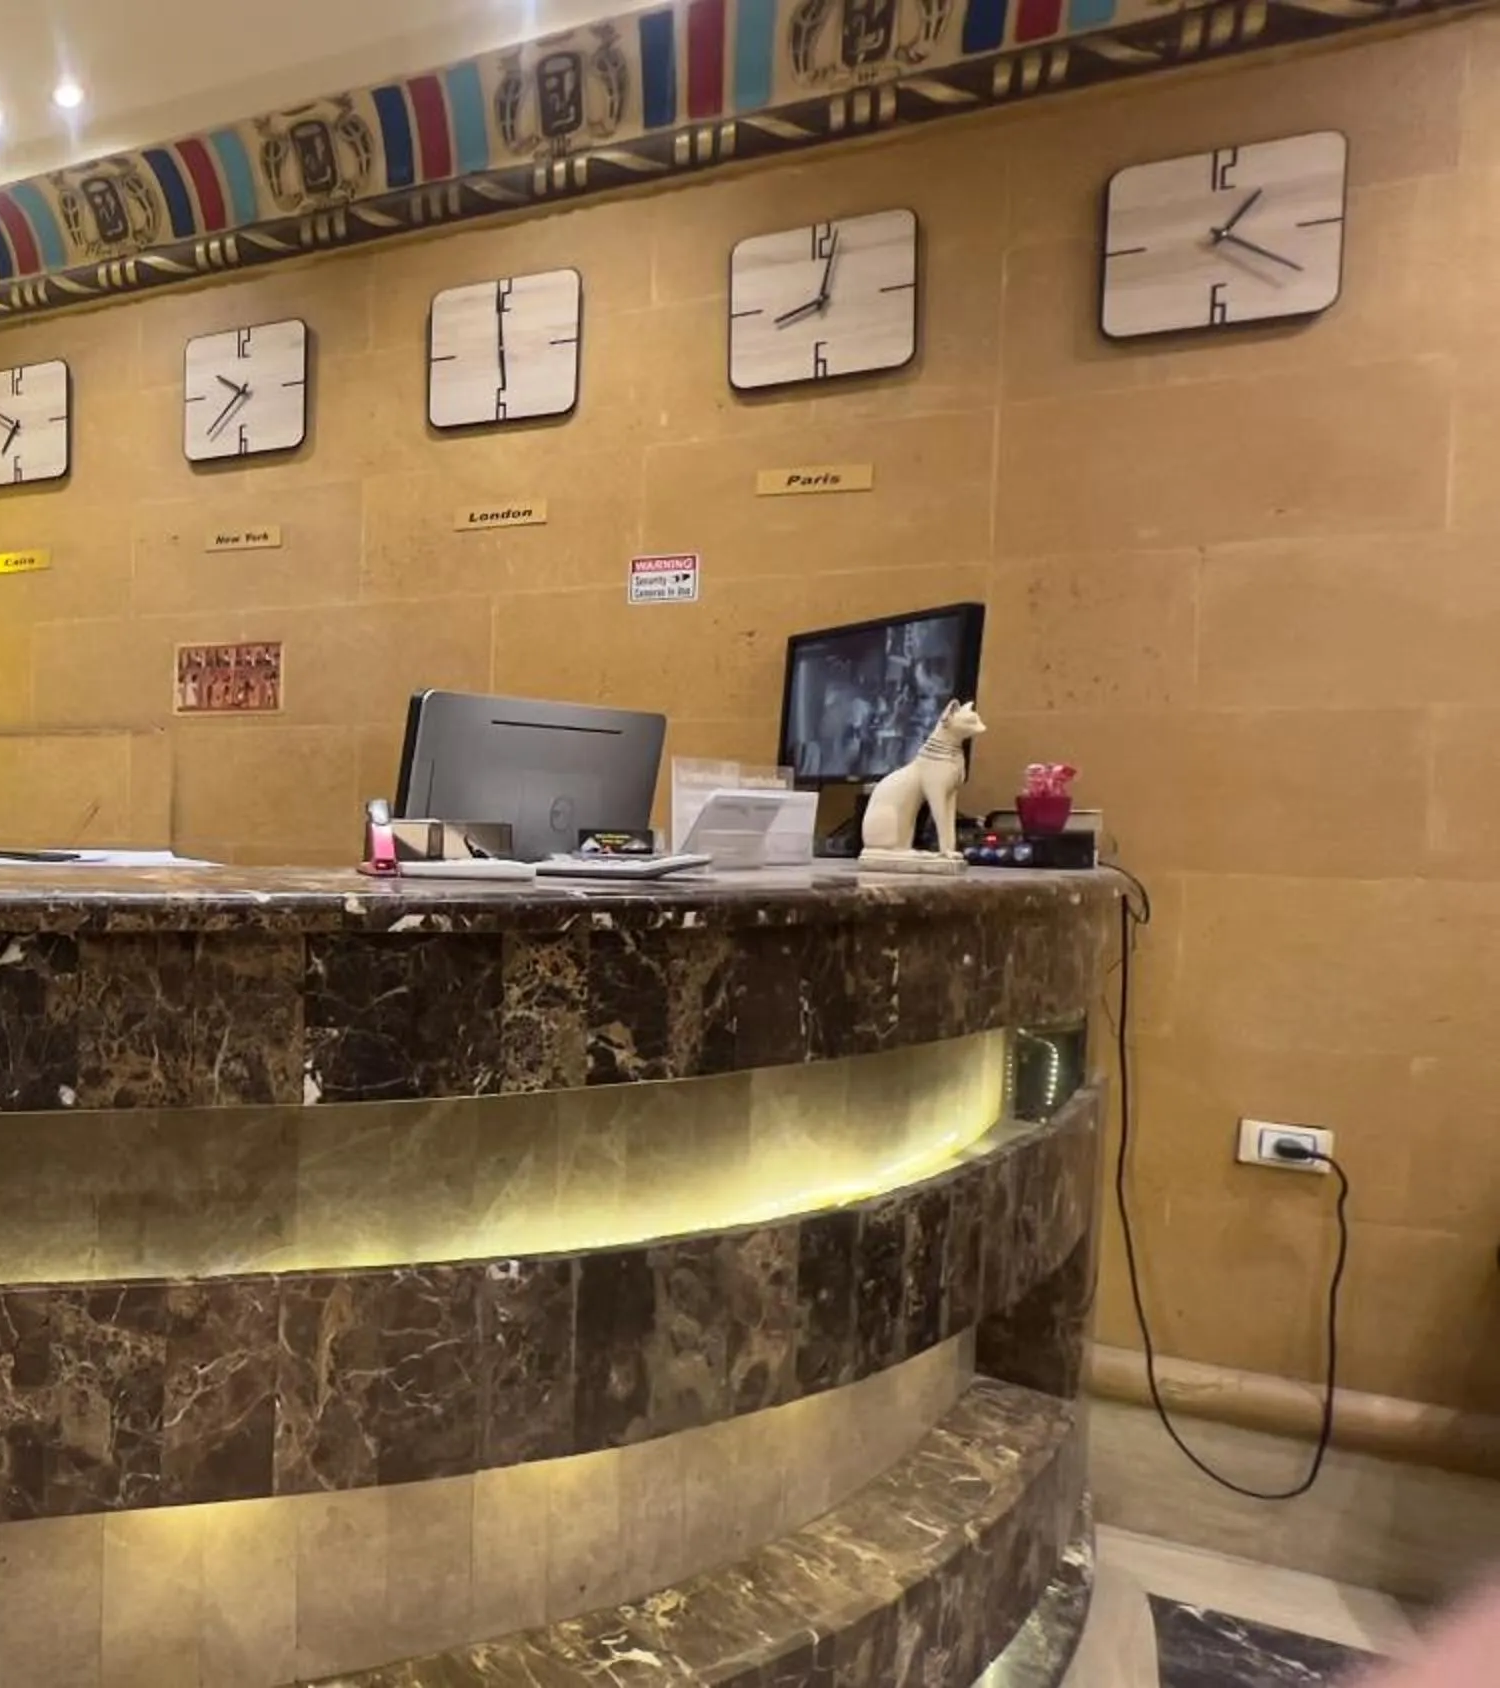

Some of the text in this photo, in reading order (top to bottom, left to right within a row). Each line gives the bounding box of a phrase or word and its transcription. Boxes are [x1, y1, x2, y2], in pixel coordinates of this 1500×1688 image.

[787, 473, 840, 486] Paris
[469, 507, 533, 523] London
[216, 532, 268, 544] New York
[635, 558, 693, 571] WARNING
